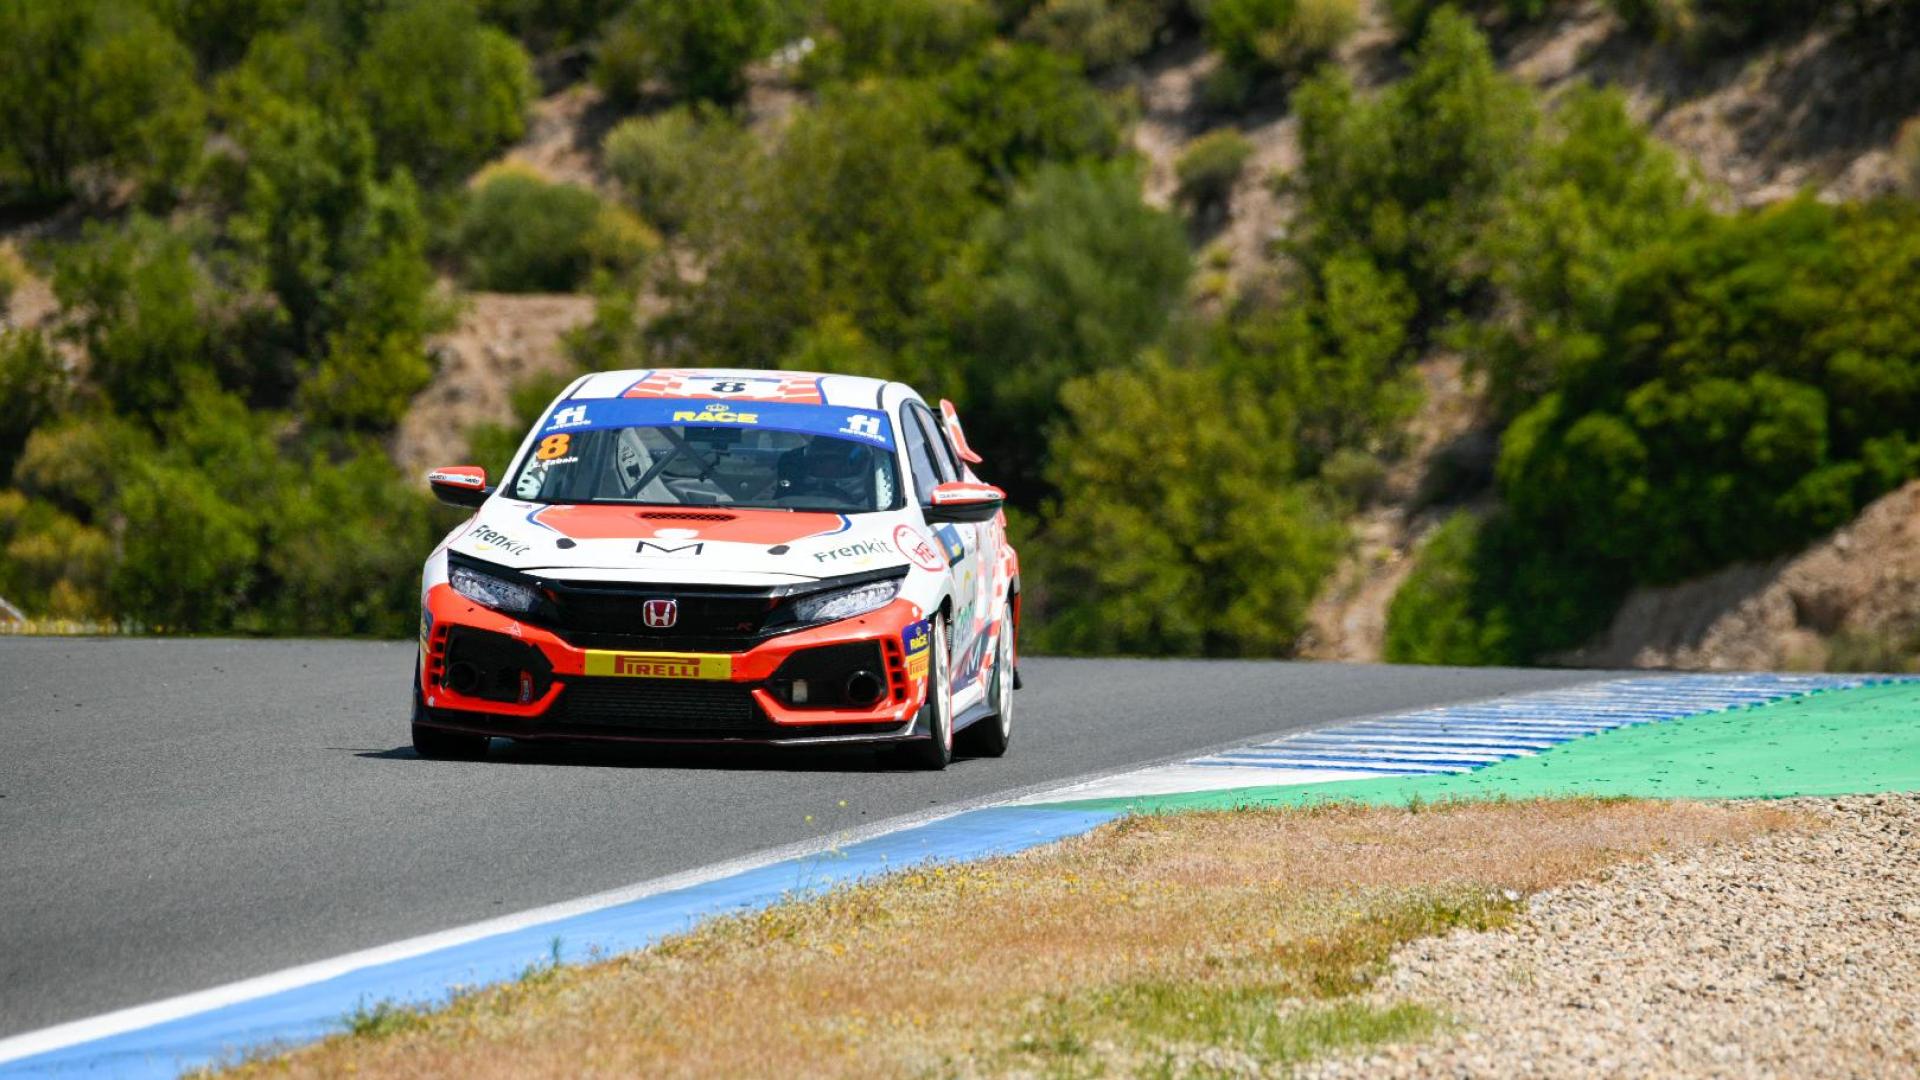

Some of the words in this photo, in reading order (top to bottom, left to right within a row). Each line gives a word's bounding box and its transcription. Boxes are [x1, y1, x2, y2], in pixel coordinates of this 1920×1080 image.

[711, 382, 746, 393] 8
[673, 411, 758, 424] RACE
[536, 432, 571, 462] 8
[468, 524, 530, 556] Frenkit
[813, 538, 894, 563] Frenkit
[910, 633, 929, 651] RACE
[614, 655, 701, 678] PIRELLI
